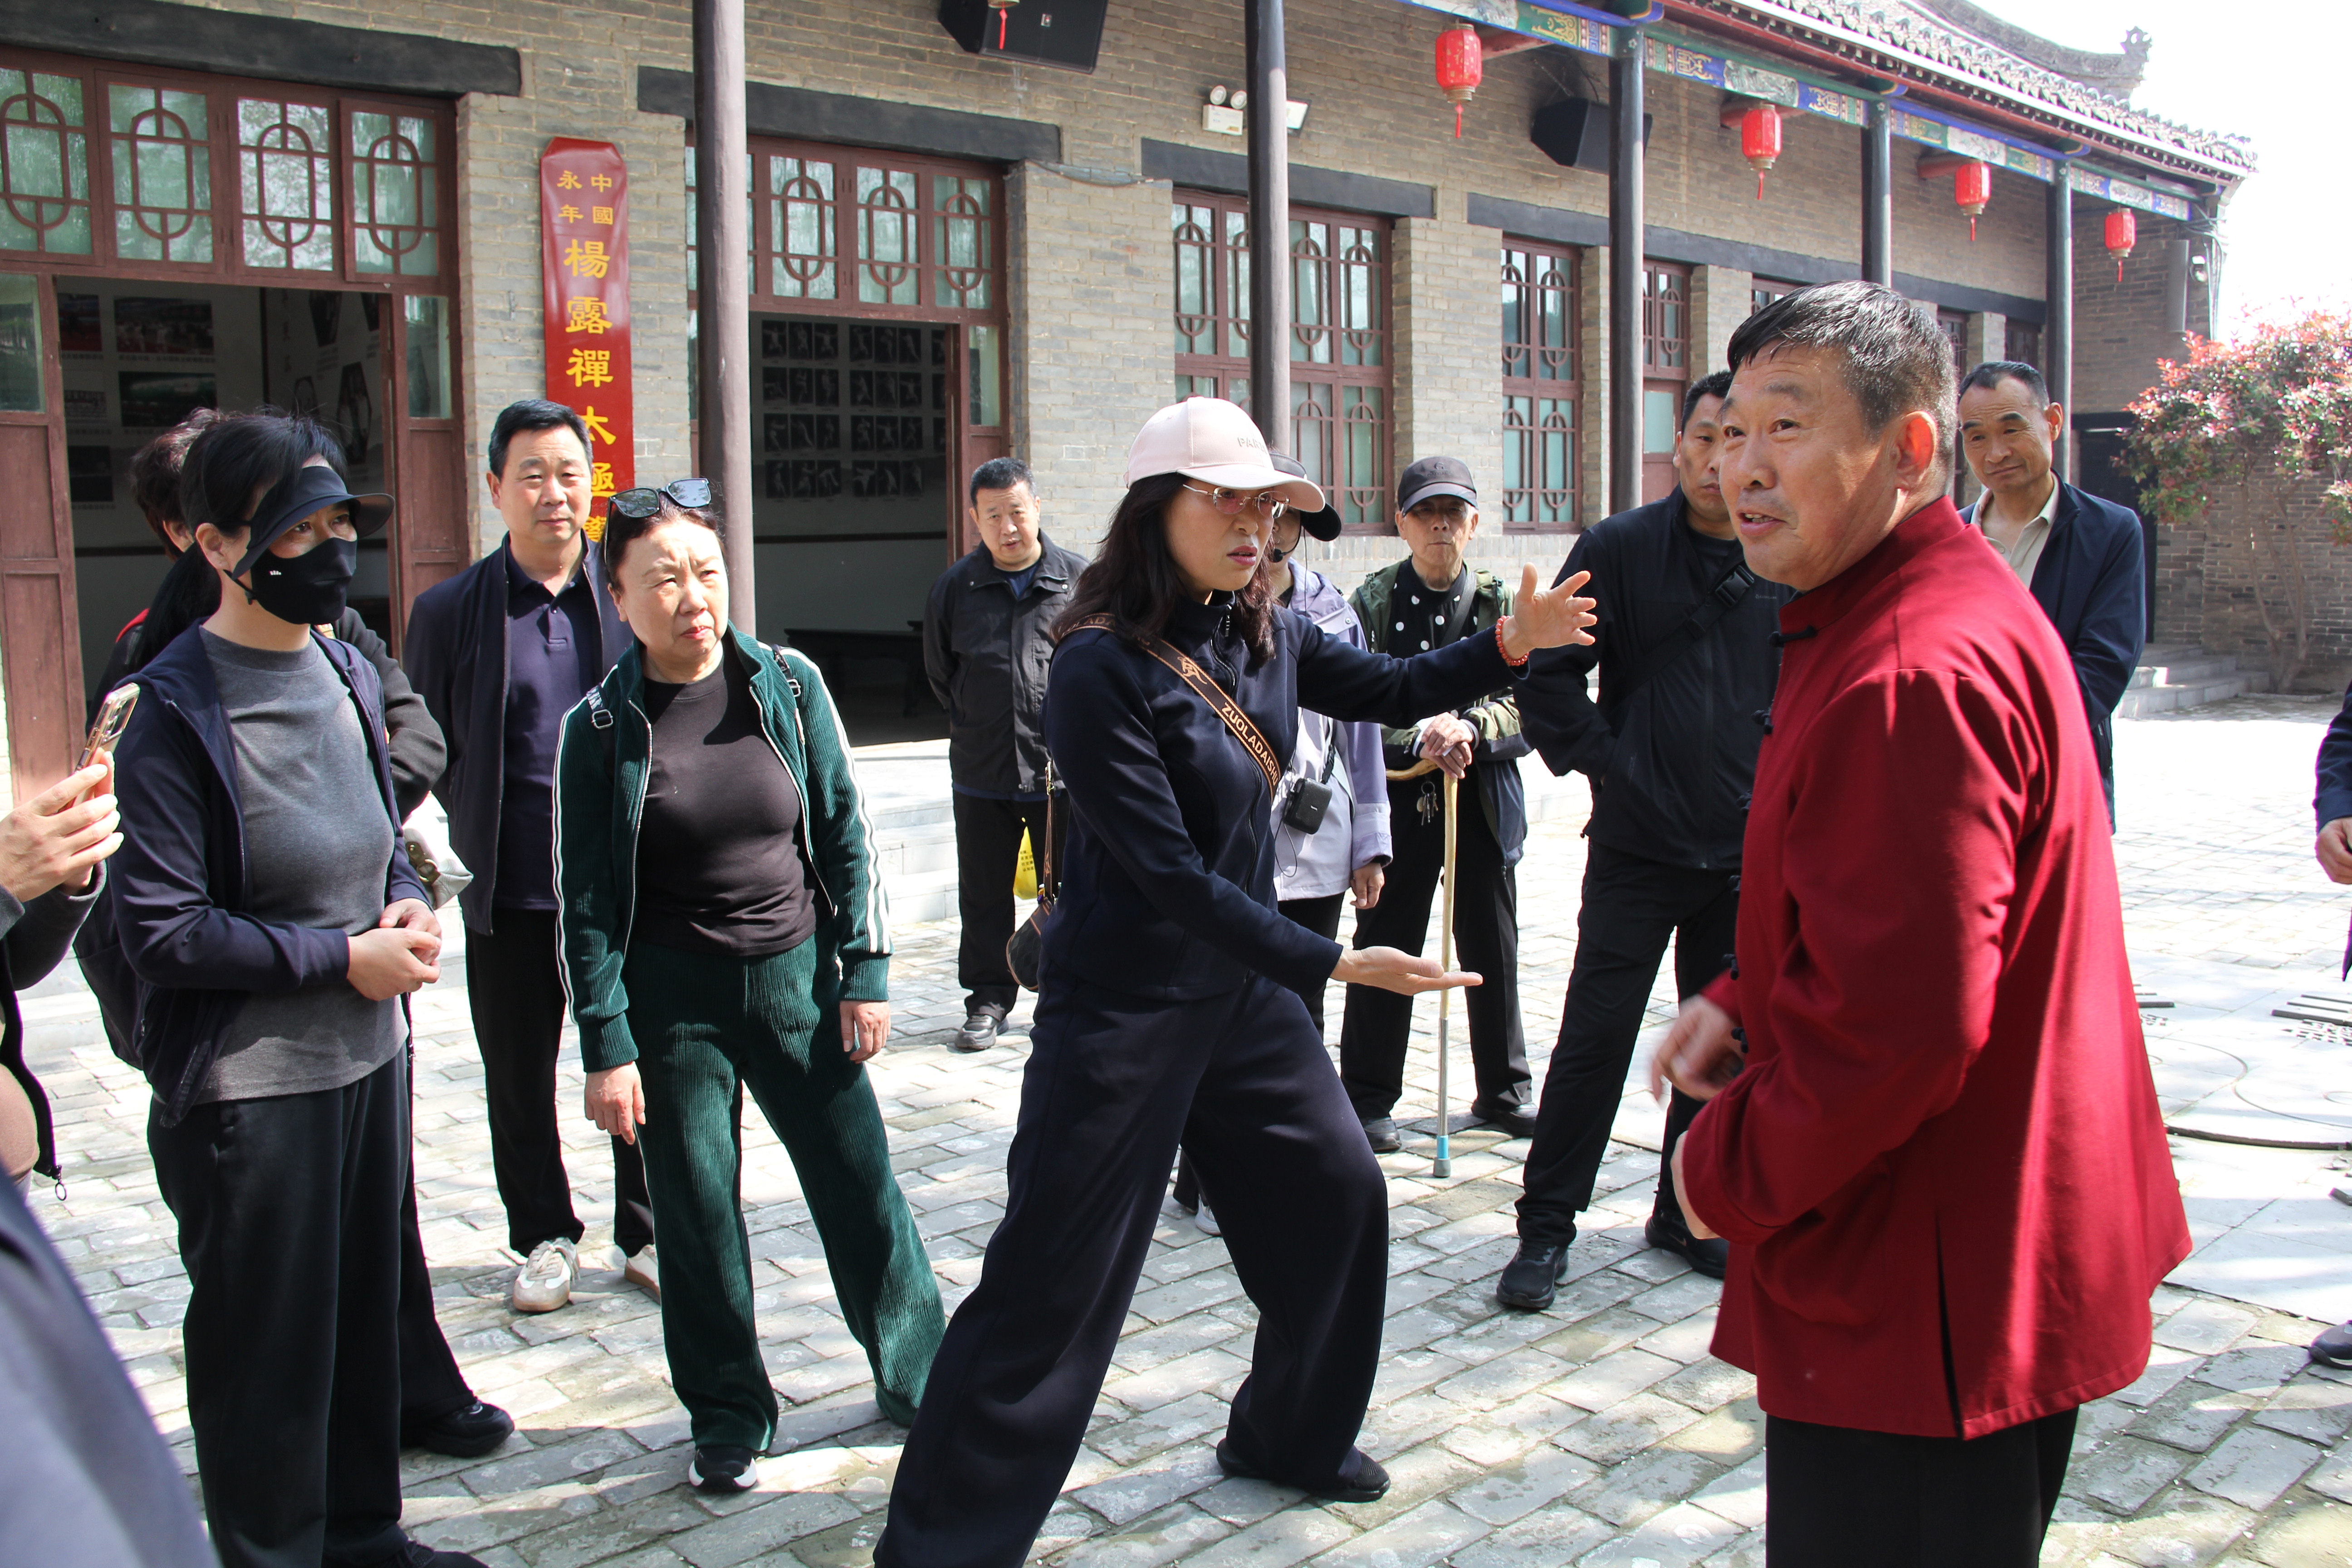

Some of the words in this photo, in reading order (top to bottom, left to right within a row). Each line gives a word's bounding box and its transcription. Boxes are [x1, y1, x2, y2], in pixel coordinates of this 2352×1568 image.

[557, 170, 584, 224] 永年
[591, 173, 613, 225] 中國
[1221, 702, 1279, 786] ZUOLADAISHU
